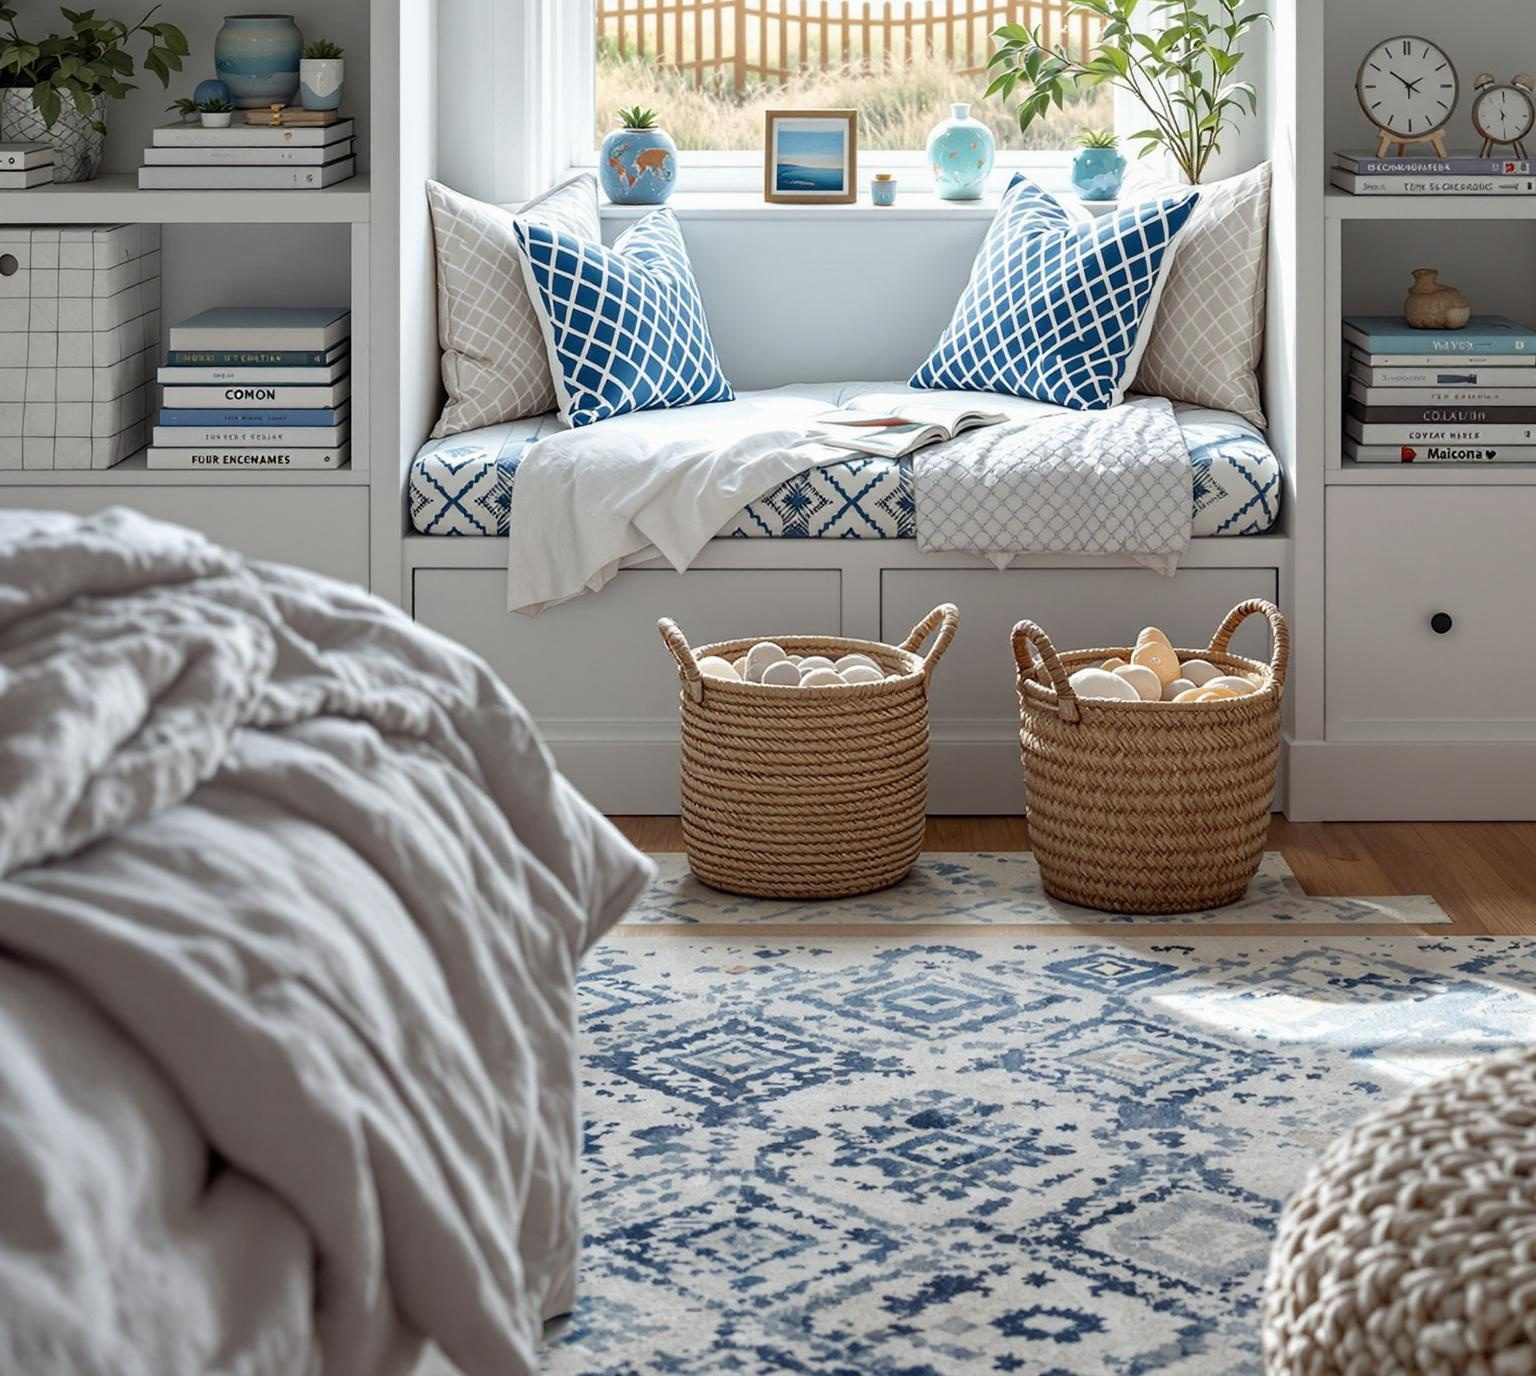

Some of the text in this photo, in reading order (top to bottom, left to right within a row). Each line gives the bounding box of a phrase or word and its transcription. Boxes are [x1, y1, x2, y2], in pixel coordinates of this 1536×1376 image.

[225, 389, 275, 400] COMON
[1427, 447, 1482, 460] Maicona
[191, 455, 219, 464] FOUR
